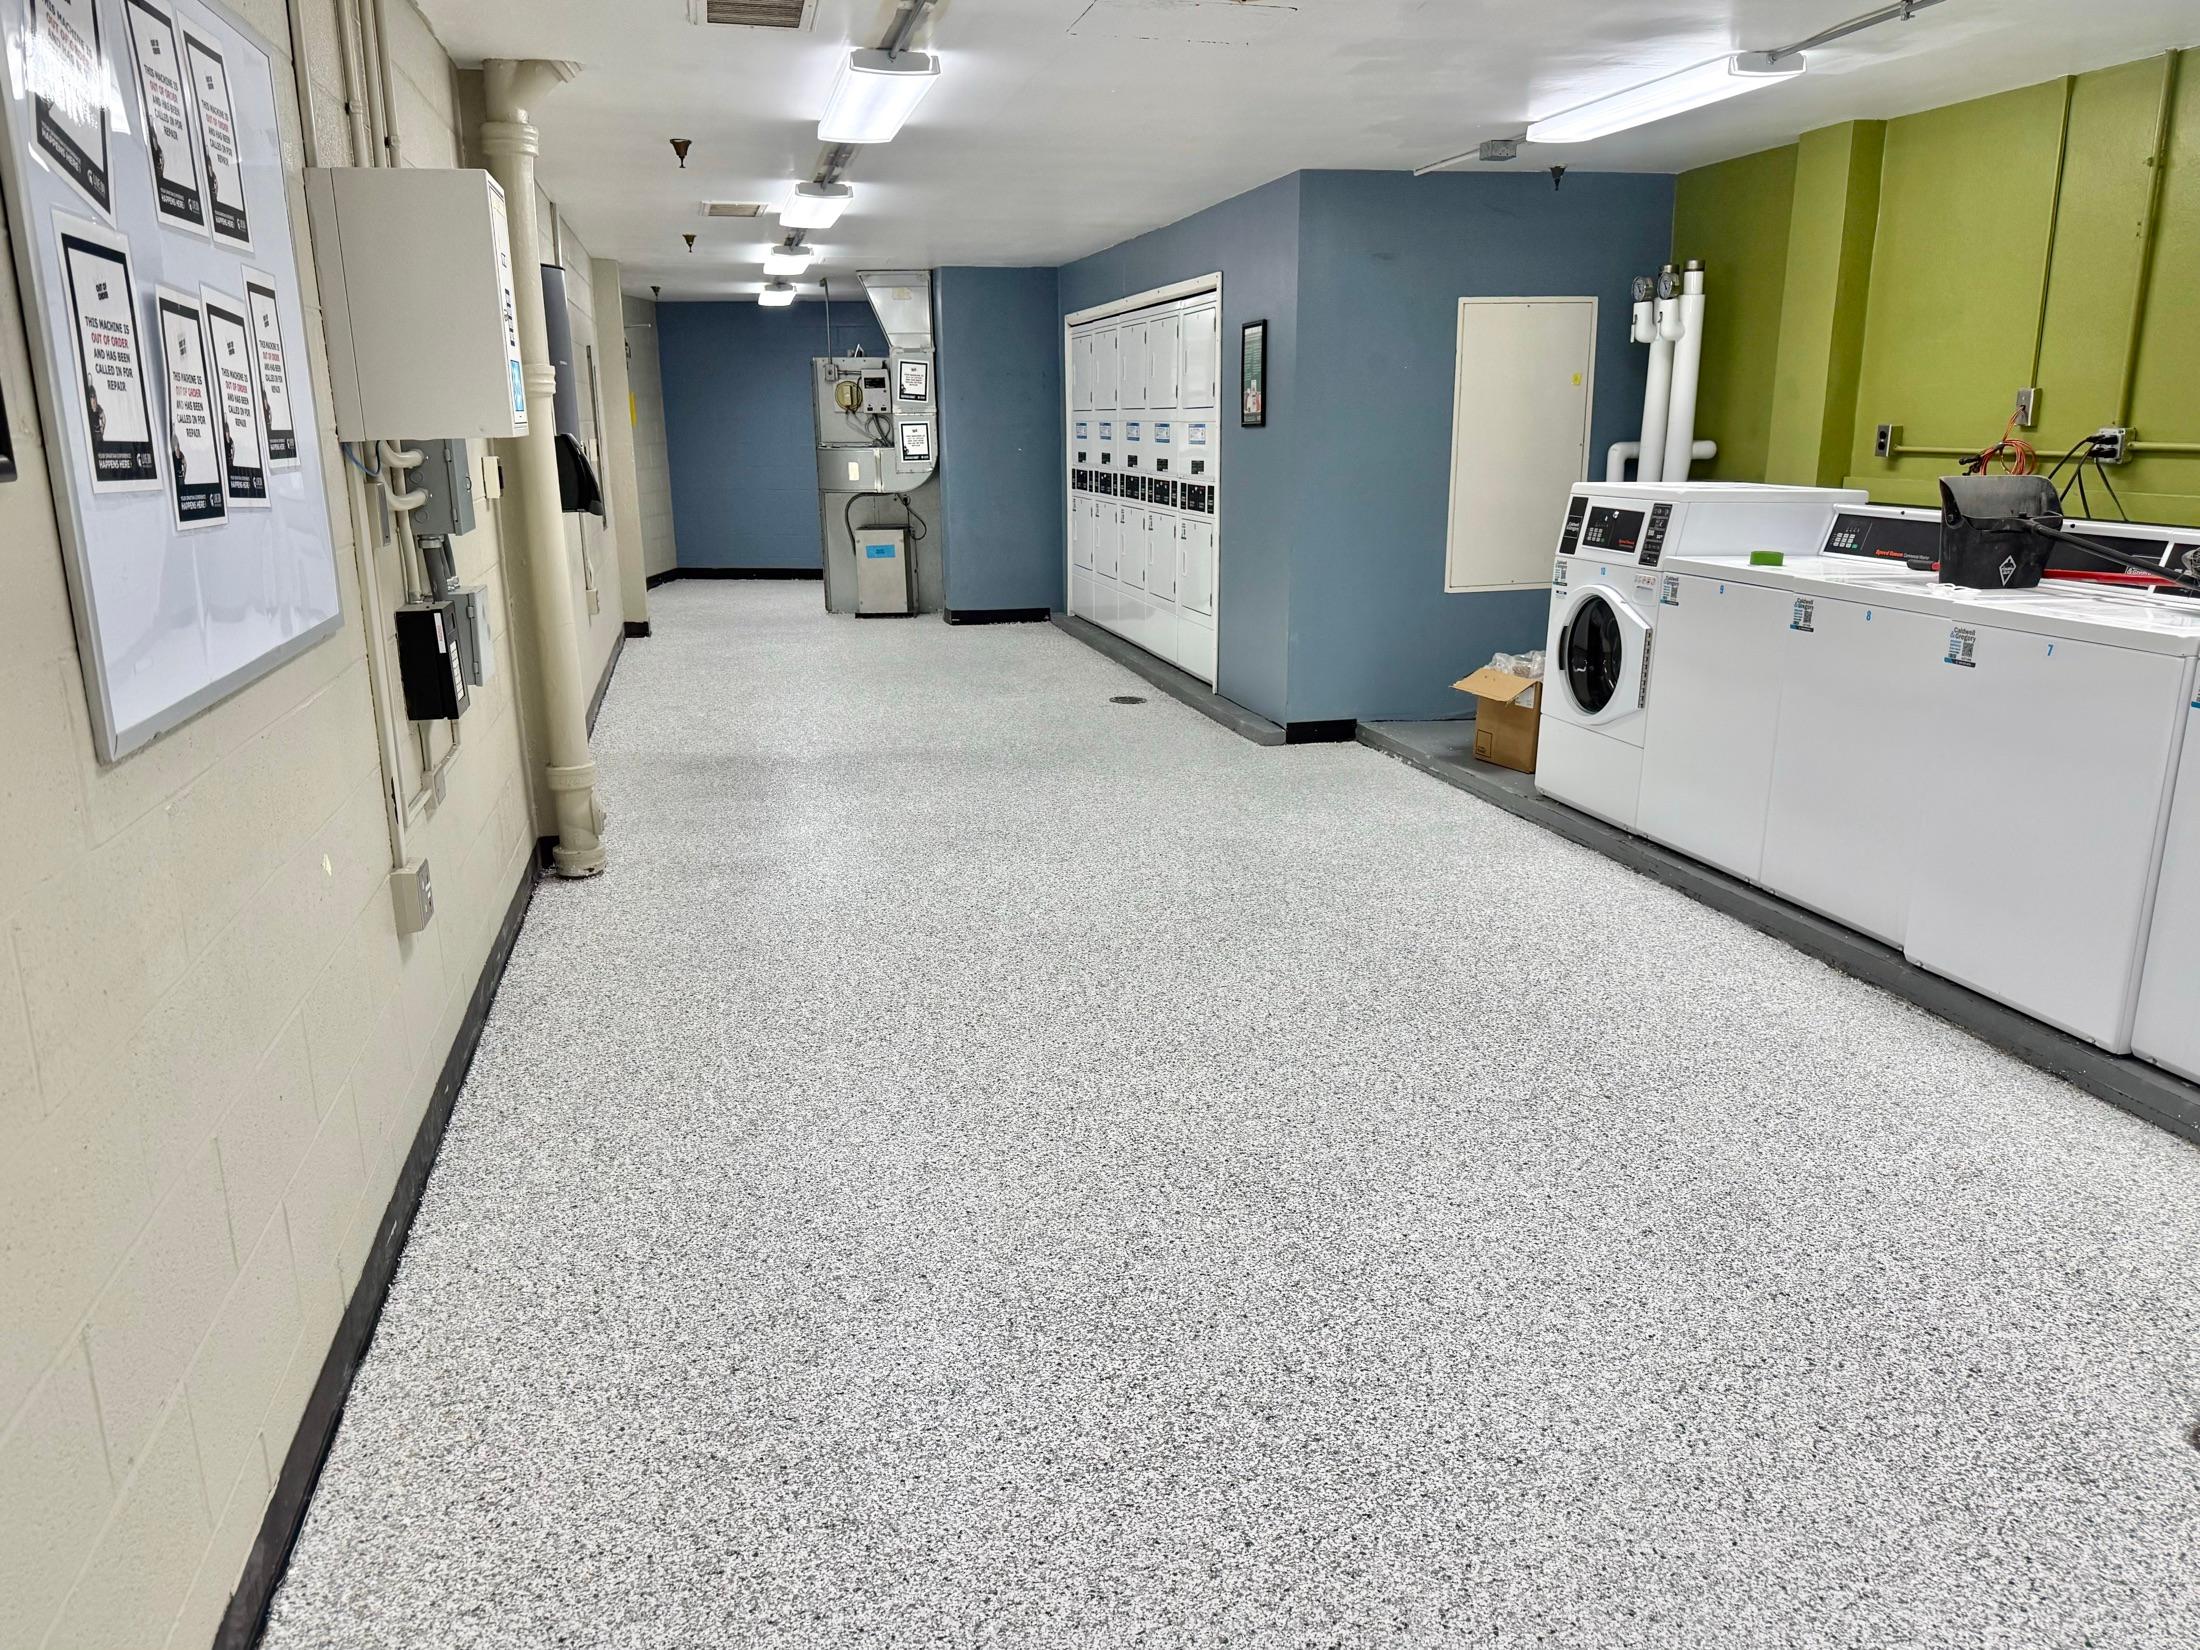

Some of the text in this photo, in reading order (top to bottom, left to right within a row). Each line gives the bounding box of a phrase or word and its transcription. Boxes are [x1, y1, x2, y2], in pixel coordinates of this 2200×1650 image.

[84, 316, 130, 335] THIS MACHINE IS
[91, 332, 129, 349] OUT OF ORDER
[94, 348, 131, 363] AND HAS BEEN
[95, 363, 133, 378] CALLED IN FOR
[107, 380, 127, 392] REPAIR
[1866, 610, 1872, 621] 8
[1953, 627, 1976, 637] Caldwell
[2047, 644, 2054, 657] 7
